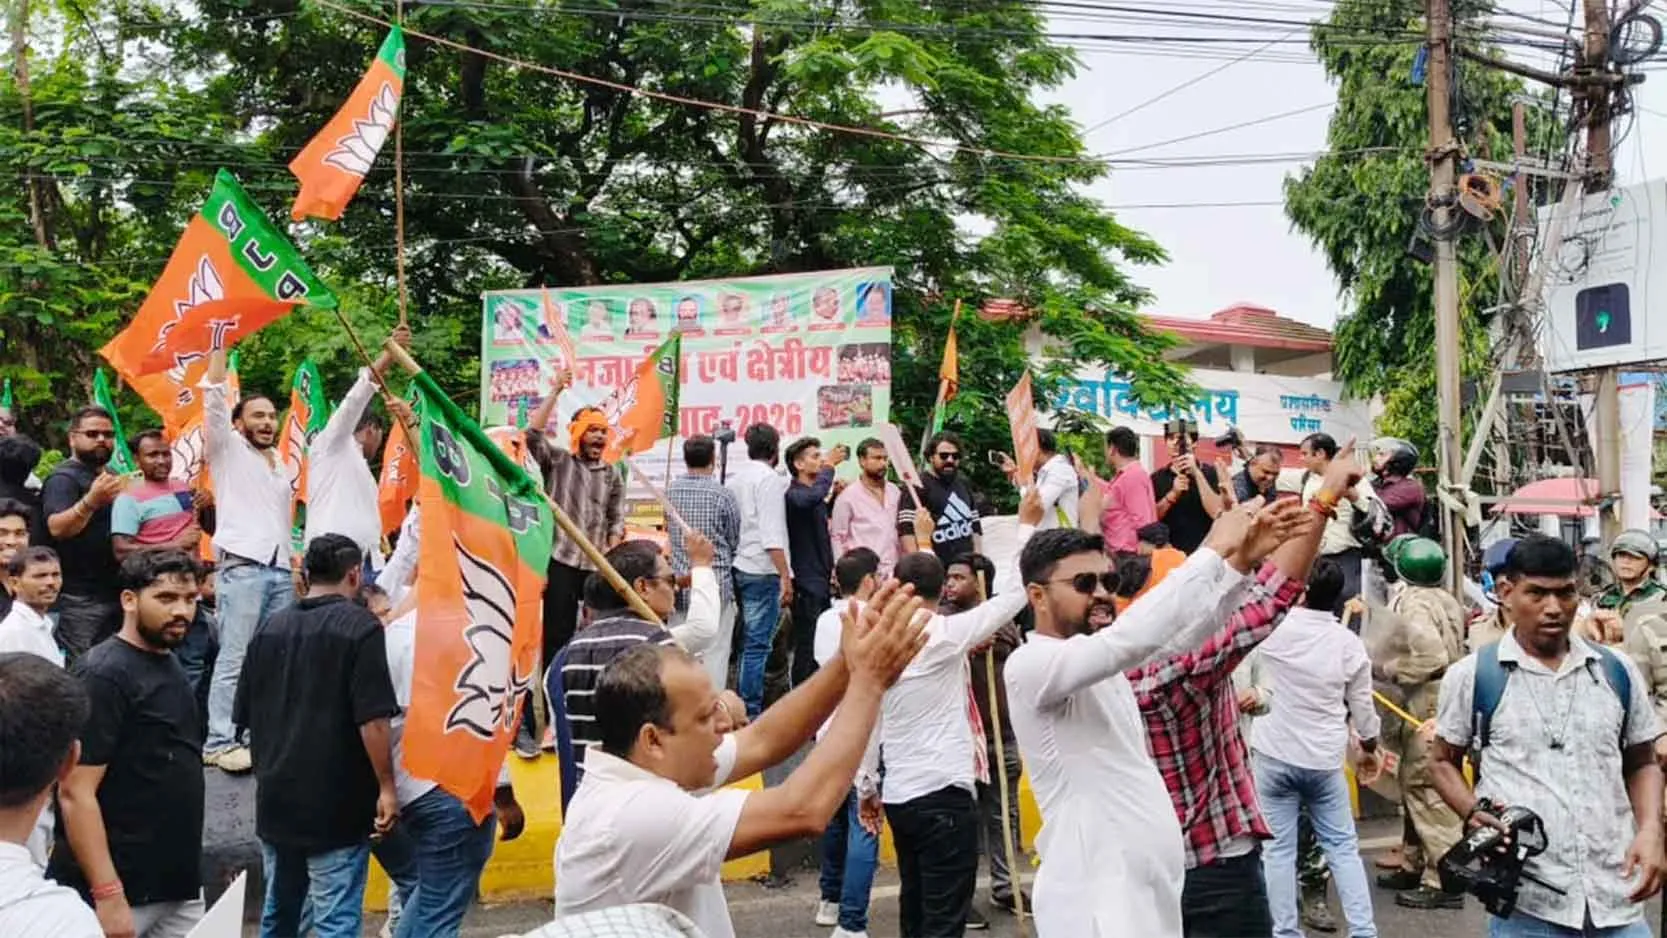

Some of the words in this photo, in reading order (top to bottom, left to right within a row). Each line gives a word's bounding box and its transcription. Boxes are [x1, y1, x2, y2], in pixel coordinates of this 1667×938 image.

[698, 341, 741, 383] एवं
[747, 338, 832, 381] क्षेत्रीय
[932, 518, 974, 543] adid
